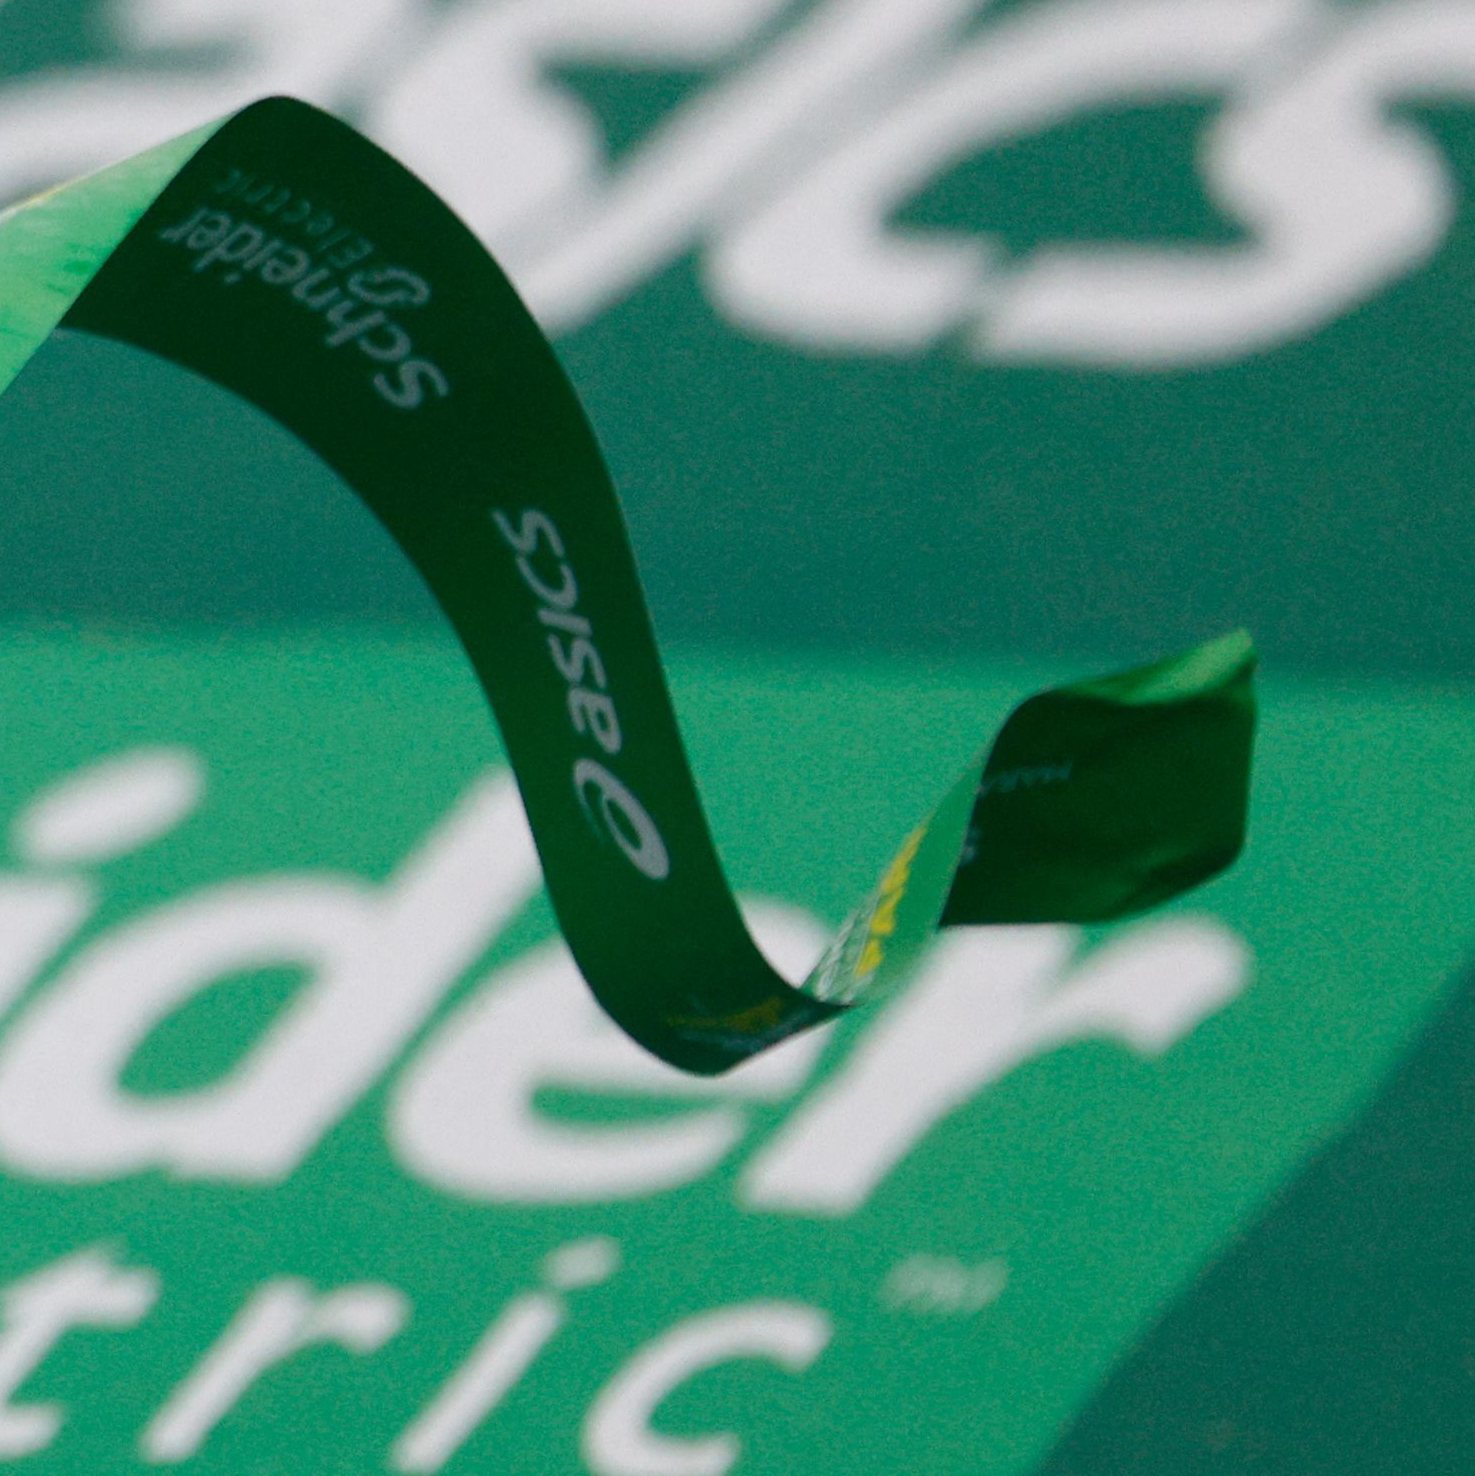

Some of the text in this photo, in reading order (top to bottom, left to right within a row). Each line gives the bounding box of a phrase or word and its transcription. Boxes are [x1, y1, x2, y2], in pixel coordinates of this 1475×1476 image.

[159, 206, 449, 409] Schneider
[215, 167, 375, 270] Electric
[491, 507, 623, 755] asics
